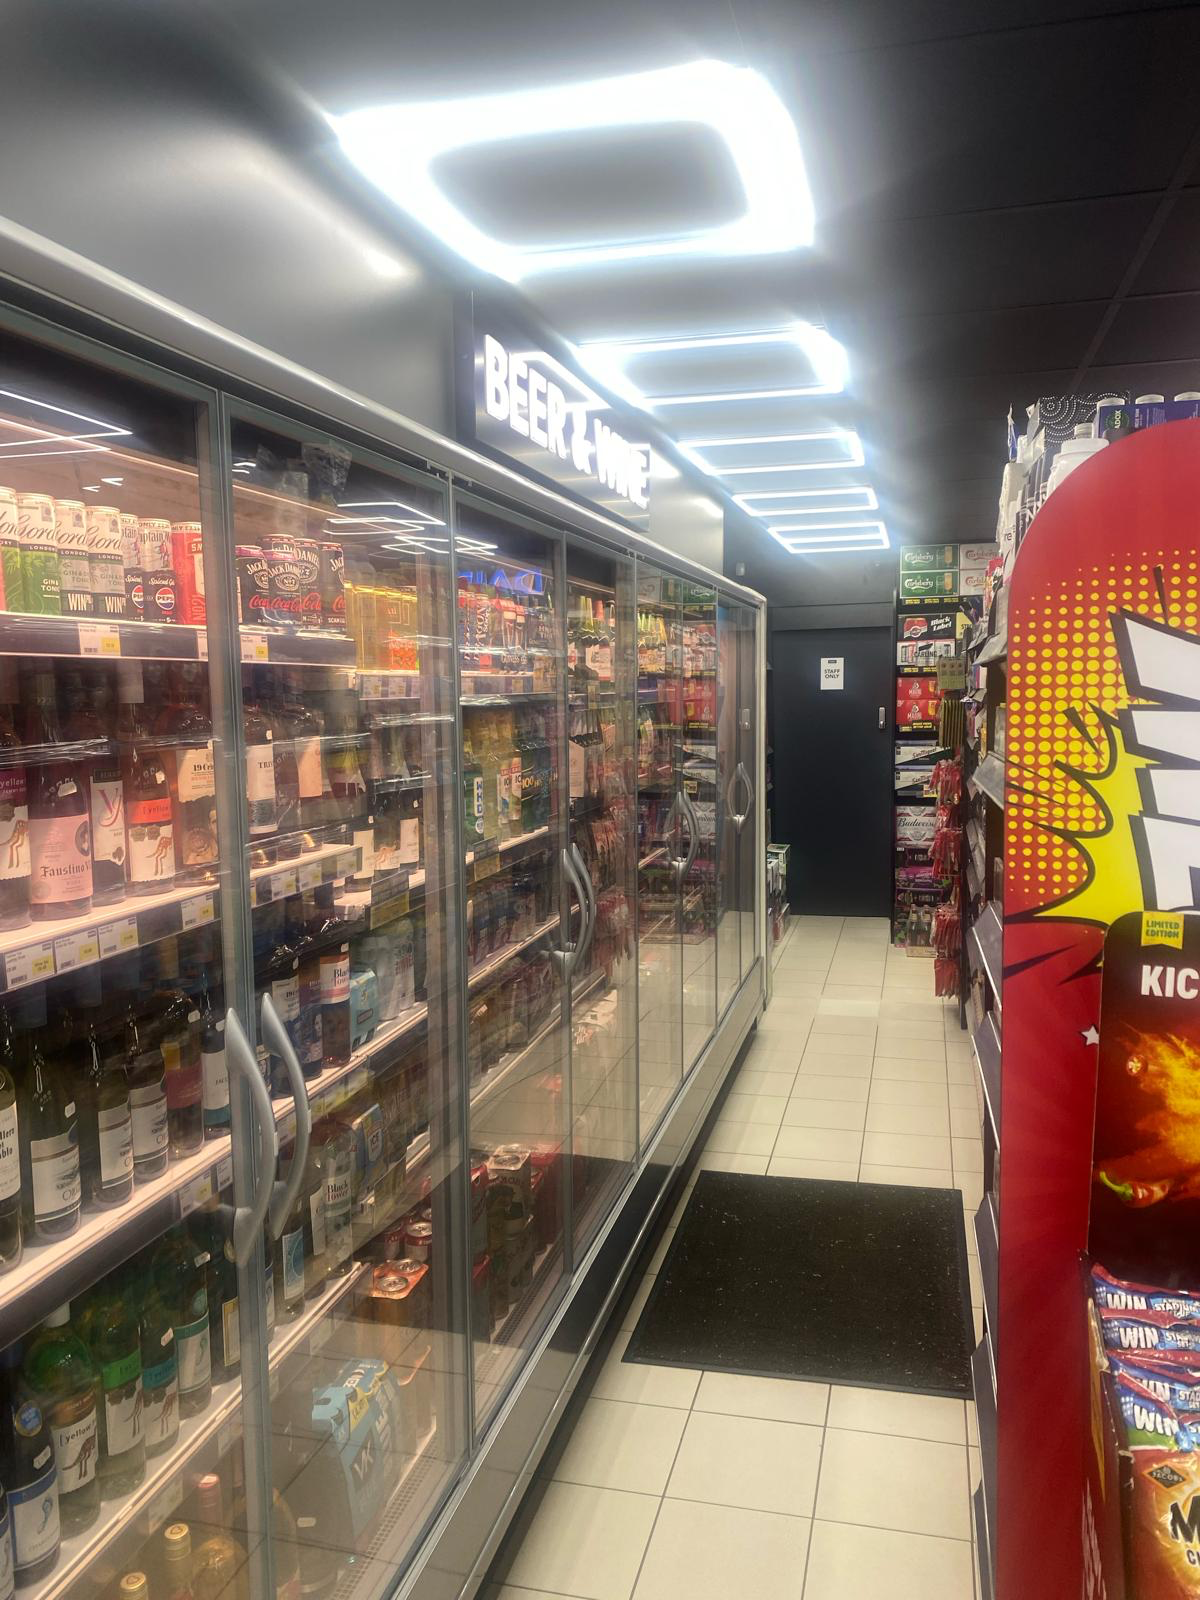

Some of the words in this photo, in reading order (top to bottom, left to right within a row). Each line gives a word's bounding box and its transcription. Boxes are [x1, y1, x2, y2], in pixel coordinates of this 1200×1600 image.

[485, 334, 567, 460] BEER
[594, 418, 648, 510] WINE
[1114, 409, 1122, 429] ADOX
[904, 578, 934, 590] Carlsberg
[67, 593, 87, 611] WIN
[930, 616, 951, 627] Black
[932, 621, 952, 632] Label
[897, 817, 934, 828] Budweis
[1146, 920, 1180, 930] LIMITED
[1146, 929, 1180, 938] EDITION
[1107, 1293, 1147, 1310] WIN
[1119, 1326, 1159, 1349] WIN
[1133, 1404, 1180, 1437] WIN
